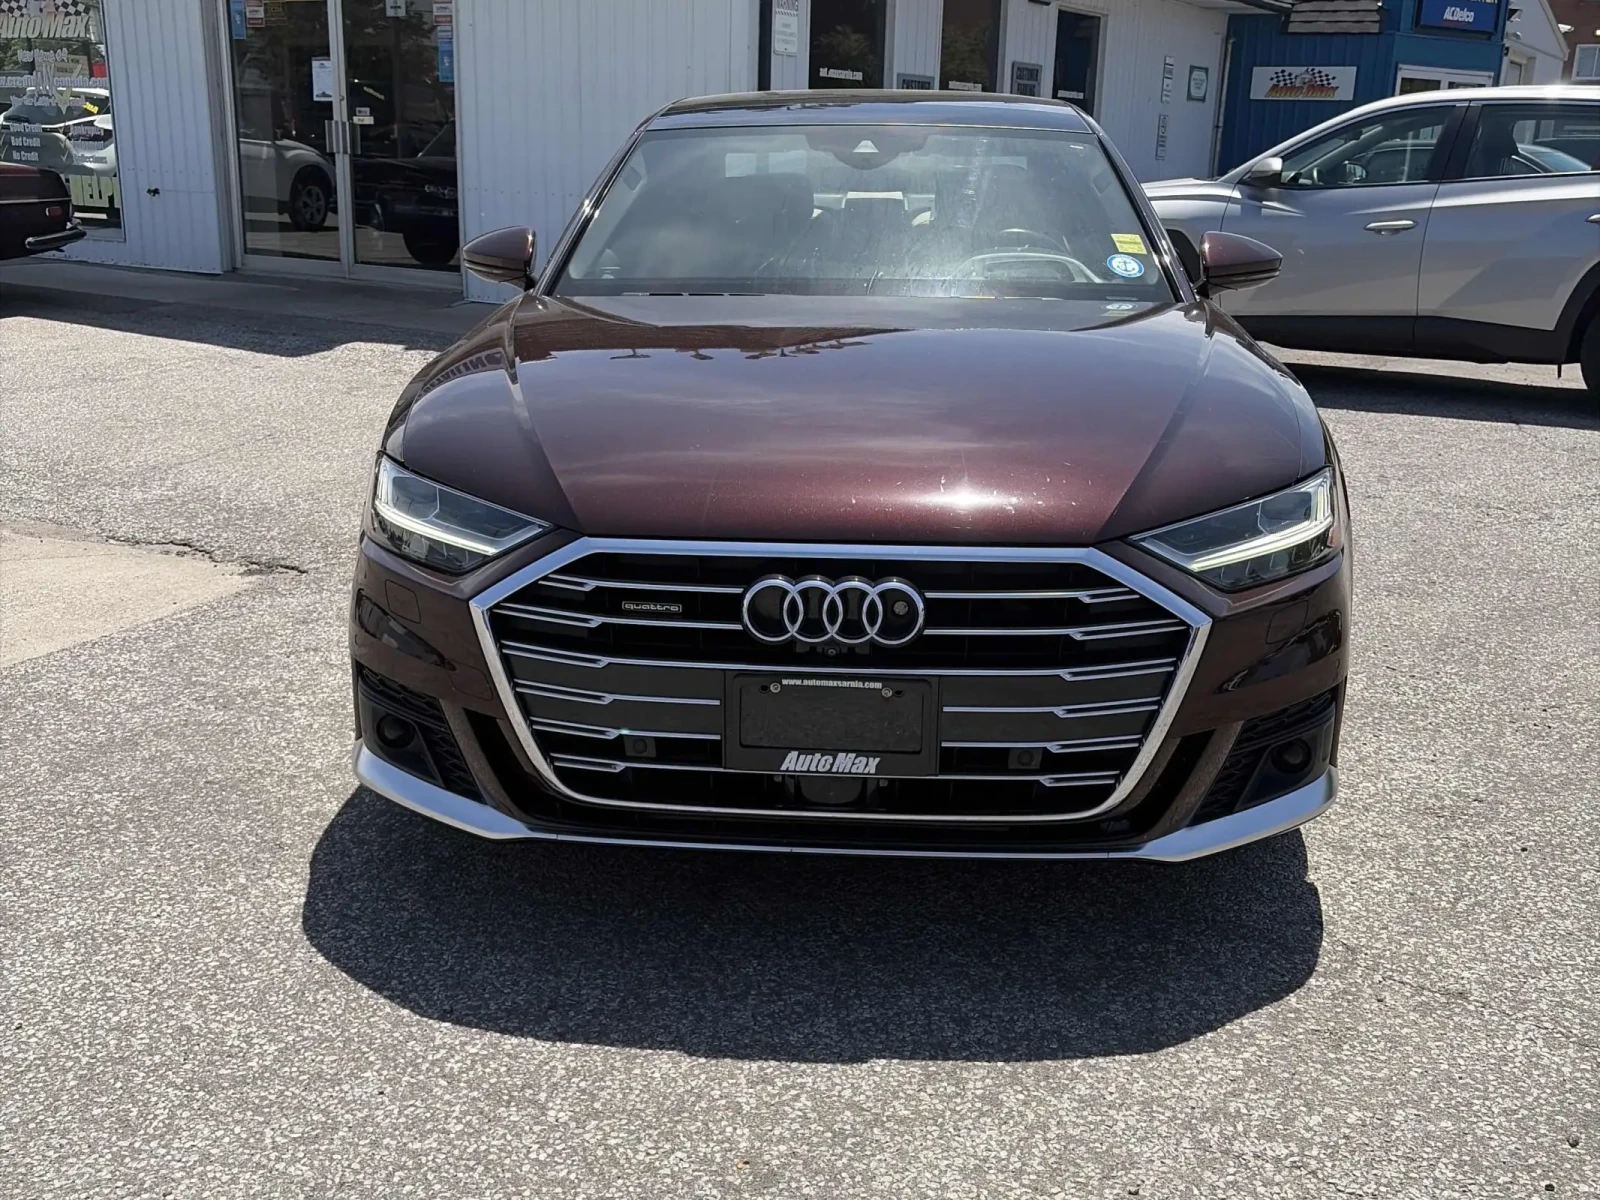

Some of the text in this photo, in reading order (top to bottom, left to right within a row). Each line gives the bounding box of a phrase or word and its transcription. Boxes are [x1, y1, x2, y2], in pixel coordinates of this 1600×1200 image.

[1443, 6, 1475, 22] ACDelco
[0, 12, 90, 38] AutoMax
[23, 137, 41, 147] Credit
[21, 151, 39, 161] Credit
[624, 603, 679, 611] quattro
[781, 678, 882, 689] www.automaxsarnia.com
